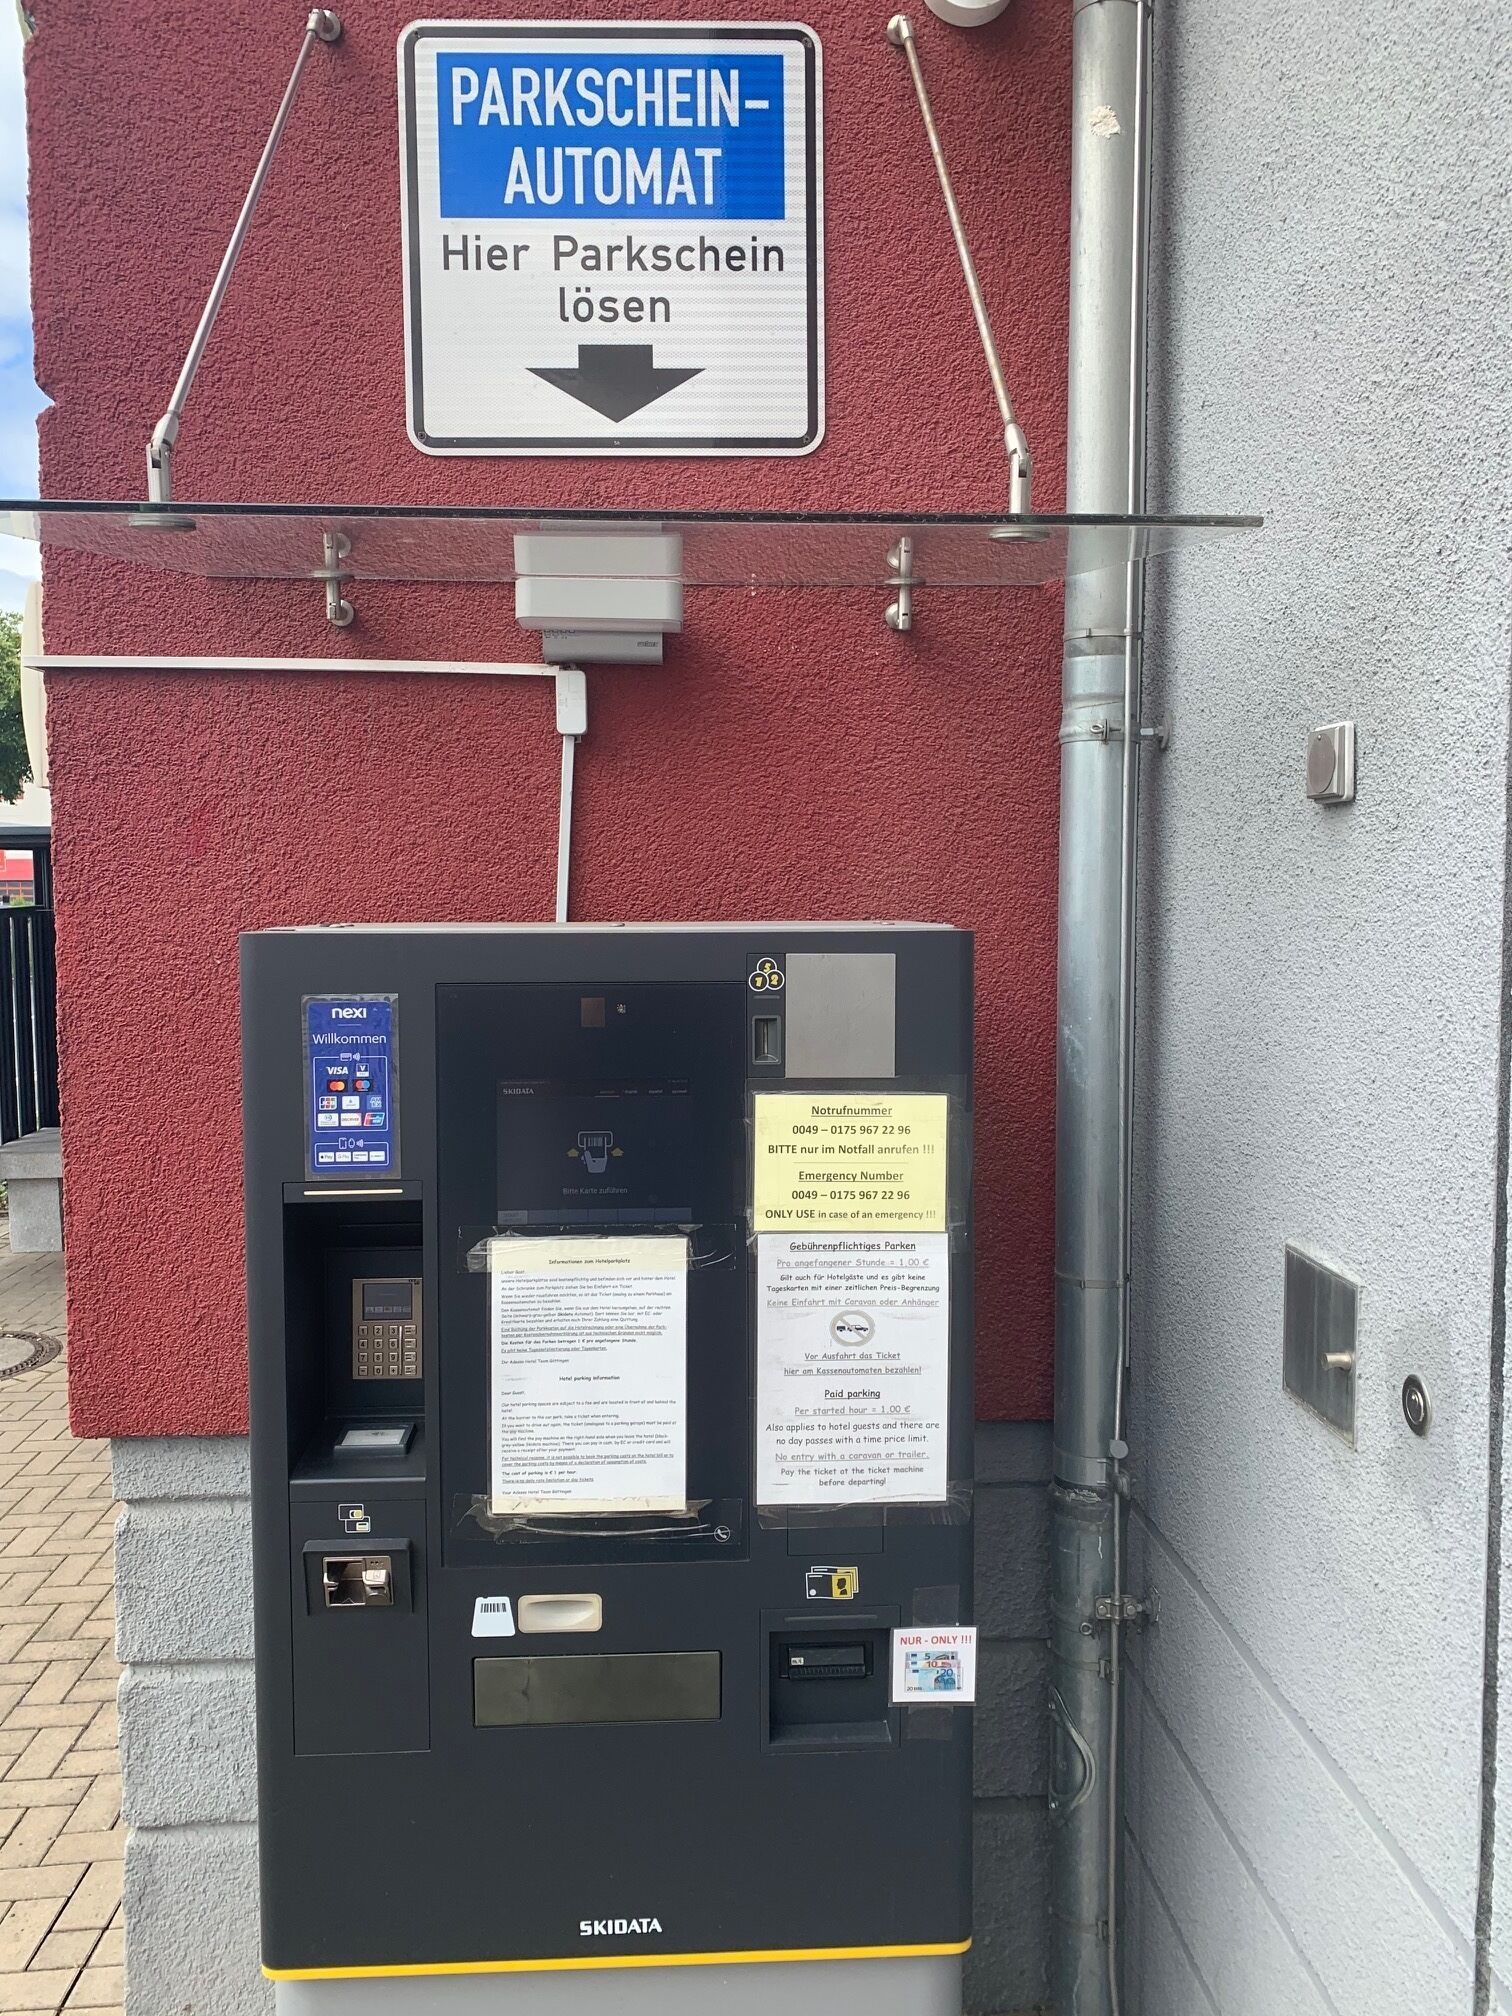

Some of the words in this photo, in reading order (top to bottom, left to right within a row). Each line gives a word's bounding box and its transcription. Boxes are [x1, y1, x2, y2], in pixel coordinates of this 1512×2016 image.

[451, 66, 769, 128] PARKSCHEIN-
[503, 146, 722, 206] AUTOMAT
[442, 234, 530, 271] Hier
[553, 234, 785, 272] Parkschein
[559, 286, 671, 323] lösen
[763, 962, 771, 972] 5
[755, 976, 763, 987] 1
[770, 974, 779, 985] 2
[331, 1007, 367, 1019] nexi
[312, 1032, 387, 1045] Willkommen
[326, 1066, 349, 1075] VISA
[503, 1087, 535, 1096] SKIDATA
[811, 1106, 893, 1115] Notrufnummer
[792, 1126, 818, 1135] 0049
[831, 1125, 856, 1135] 0175
[860, 1125, 879, 1135] 967
[882, 1125, 894, 1135] 22
[898, 1125, 911, 1134] 96
[768, 1145, 797, 1154] BITTE
[822, 1145, 835, 1154] im
[839, 1145, 874, 1154] Notfall
[878, 1145, 919, 1154] anrufen
[923, 1145, 934, 1154] !!!
[798, 1171, 858, 1182] Emergency
[860, 1171, 904, 1180] Number
[791, 1191, 818, 1200] 0049
[829, 1191, 856, 1200] 0175
[858, 1191, 879, 1200] 967
[881, 1191, 895, 1200] 22
[896, 1191, 910, 1200] 96
[765, 1210, 793, 1219] ONLY
[796, 1210, 816, 1219] USE
[818, 1210, 827, 1219] in
[850, 1210, 860, 1219] of
[875, 1212, 924, 1220] emergency
[926, 1210, 936, 1219] !!!
[789, 1242, 881, 1252] Gebührenpflichtiges
[884, 1242, 916, 1250] Parken
[776, 1258, 791, 1267] Pro
[794, 1258, 852, 1269] angefangener
[856, 1257, 886, 1267] Stunde
[827, 1274, 864, 1283] Hotelgäste
[891, 1273, 906, 1282] gibt
[766, 1285, 809, 1294] Tageskarten
[824, 1284, 843, 1292] einer
[844, 1284, 878, 1292] zeitlichen
[880, 1284, 940, 1294] Preis-Begrenzung
[879, 1298, 898, 1306] oder
[901, 1298, 940, 1308] Anhänger
[824, 1389, 844, 1398] Paid
[847, 1389, 881, 1400] parking
[794, 1406, 810, 1415] Per
[812, 1406, 846, 1414] started
[848, 1406, 868, 1414] hour
[766, 1423, 784, 1431] Also
[786, 1422, 815, 1433] applies
[817, 1422, 827, 1430] to
[829, 1422, 851, 1430] hotel
[852, 1421, 880, 1432] guests
[882, 1421, 897, 1429] and
[900, 1421, 923, 1429] there
[788, 1436, 804, 1446] day
[805, 1437, 834, 1446] passes
[835, 1435, 854, 1444] with
[863, 1435, 882, 1443] time
[884, 1434, 906, 1445] price
[775, 1452, 788, 1461] No
[791, 1452, 815, 1462] entry
[818, 1452, 836, 1460] with
[780, 1467, 795, 1477] Pay
[797, 1467, 811, 1475] the
[814, 1467, 837, 1475] ticket
[851, 1466, 865, 1474] the
[868, 1466, 890, 1474] ticket
[893, 1465, 924, 1473] machine
[819, 1478, 845, 1486] before
[900, 1636, 922, 1645] NUR
[931, 1635, 958, 1644] ONLY
[961, 1635, 972, 1644] !!!
[940, 1669, 953, 1677] 20
[579, 1917, 663, 1936] SKIDATA
